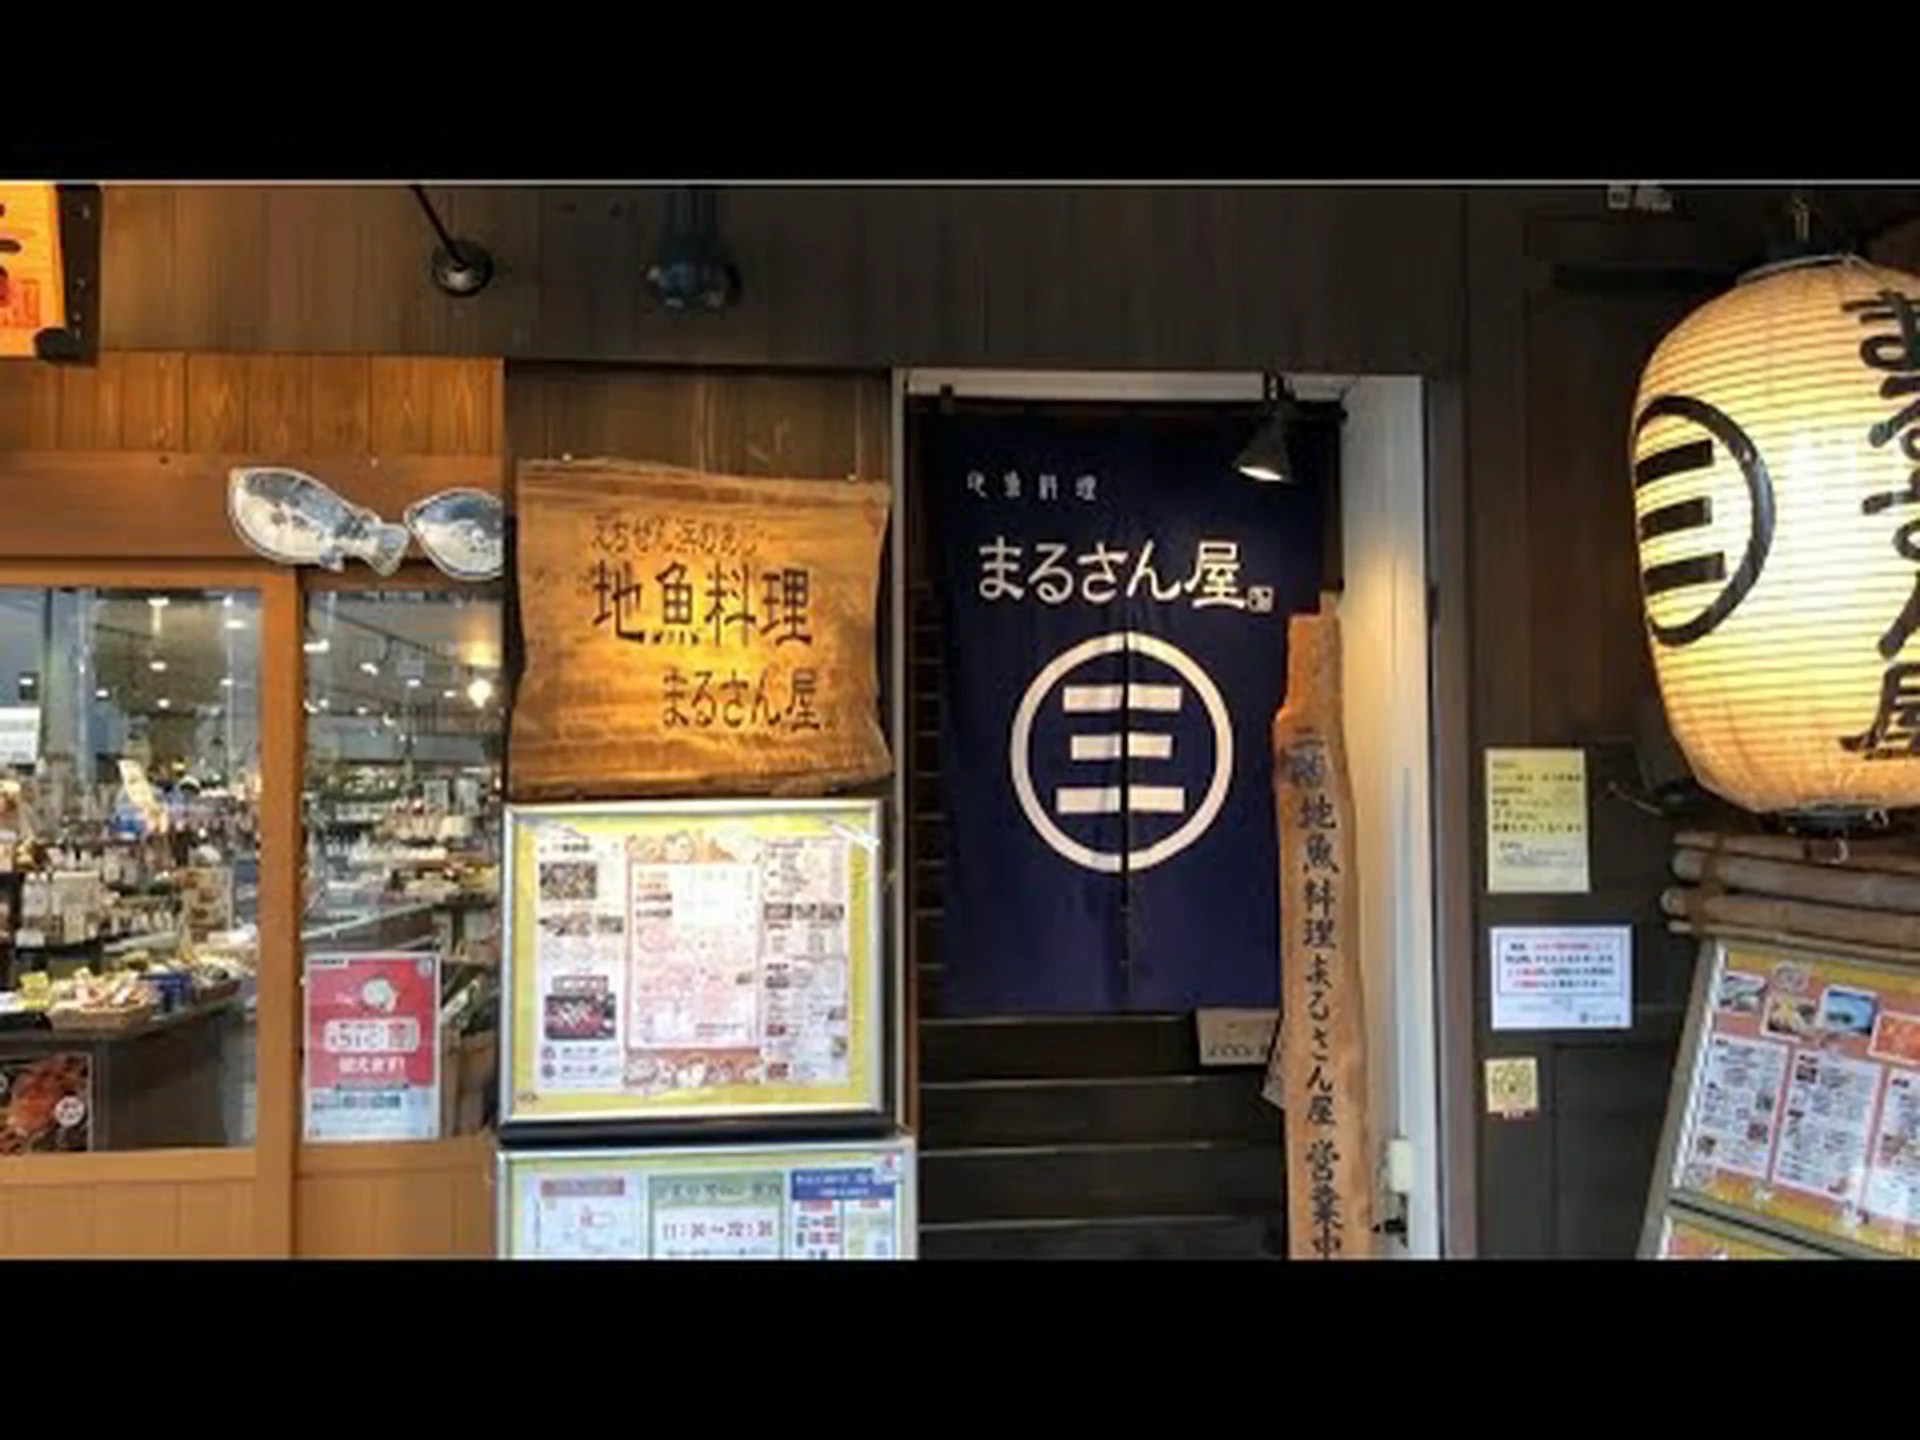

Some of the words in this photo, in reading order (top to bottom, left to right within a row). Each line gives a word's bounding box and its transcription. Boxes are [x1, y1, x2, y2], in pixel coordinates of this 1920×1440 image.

[592, 560, 814, 647] 地魚料理
[978, 535, 1246, 609] まるさん屋
[662, 668, 821, 731] まるさん屋
